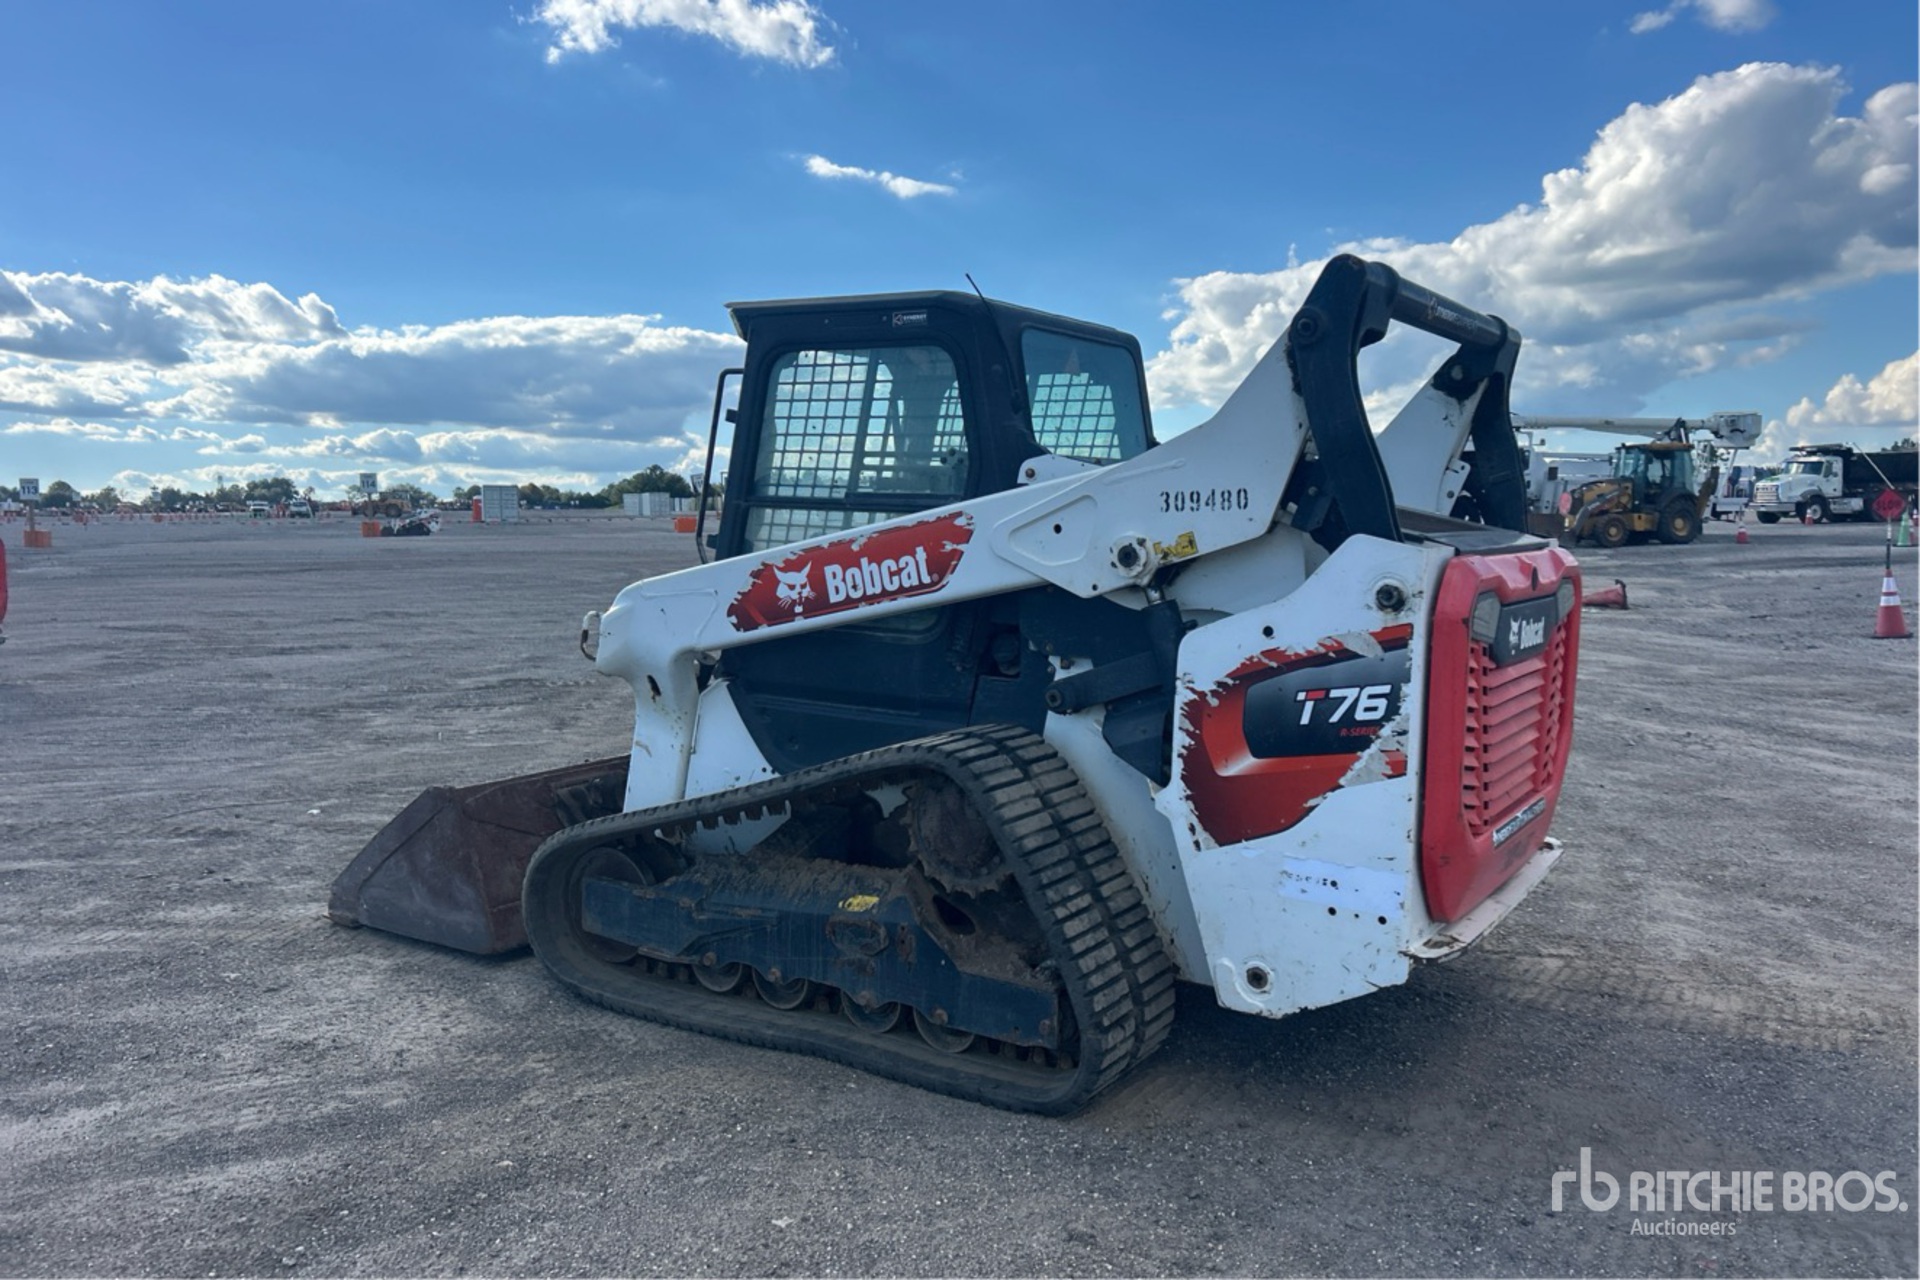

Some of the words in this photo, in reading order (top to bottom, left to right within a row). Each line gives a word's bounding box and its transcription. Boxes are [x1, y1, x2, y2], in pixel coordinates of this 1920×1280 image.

[20, 485, 39, 495] 113
[361, 479, 377, 489] 114
[1159, 487, 1249, 513] 309480
[823, 546, 932, 604] Bobcat
[1520, 616, 1545, 650] Bobcat
[1296, 684, 1393, 725] T76
